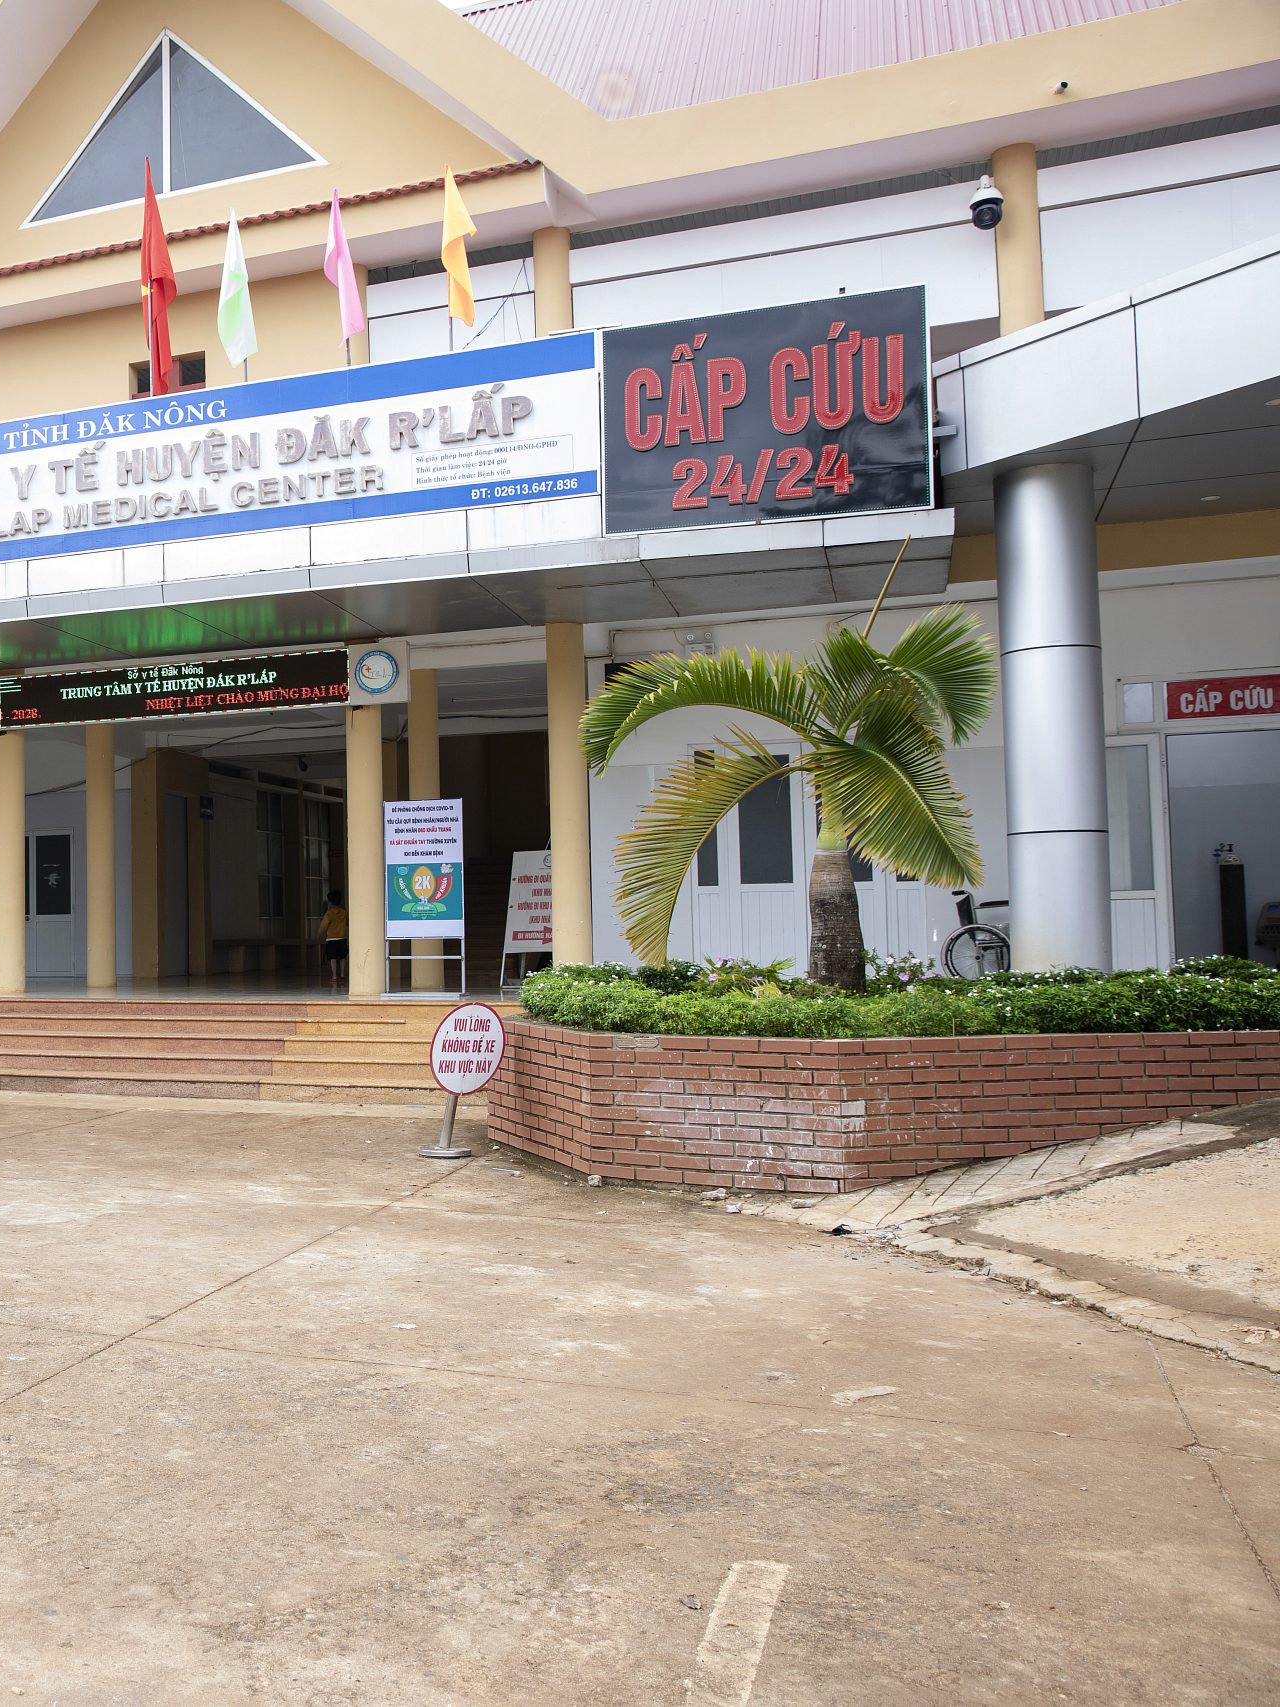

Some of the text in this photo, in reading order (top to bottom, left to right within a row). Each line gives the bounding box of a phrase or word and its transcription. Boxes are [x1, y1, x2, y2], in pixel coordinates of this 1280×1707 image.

[624, 321, 905, 452] CẤP CỨU
[4, 422, 70, 450] TỈNH
[77, 411, 136, 439] ĐĂK
[143, 399, 228, 429] NÔNG
[10, 464, 38, 501] Y
[48, 440, 106, 495] TẾ
[116, 428, 261, 487] HUYỆN
[275, 414, 371, 465] ĐĂK
[458, 449, 473, 460] hoạt
[416, 464, 431, 474] Thời
[432, 463, 447, 474] gian
[478, 459, 495, 468] 24/24
[477, 469, 495, 480] Bệnh
[496, 468, 511, 478] viện
[671, 444, 855, 511] 24/24
[63, 487, 219, 530] MEDICAL
[230, 464, 385, 508] CENTER
[471, 478, 578, 500] ĐT: 02613.647.836
[127, 669, 139, 680] Sở
[149, 667, 159, 678] tế
[181, 665, 204, 676] Nông
[60, 685, 102, 700] TRUNG
[104, 681, 132, 697] TÂM
[134, 683, 143, 695] Y
[144, 678, 161, 693] TẾ
[162, 677, 204, 693] HUYỆN
[144, 696, 183, 712] NHIỆT
[186, 693, 215, 709] LIỆT
[217, 689, 255, 705] CHÀO
[257, 686, 299, 702] MỪNG
[301, 685, 326, 701] ĐẠI
[1180, 684, 1273, 714] CẤP CỨU
[414, 875, 431, 890] 2K
[453, 1016, 491, 1032] VUI LÒNG
[441, 1036, 470, 1053] KHÔNG
[484, 1039, 496, 1053] XE
[438, 1057, 492, 1078] KHU VỰC NÀY
